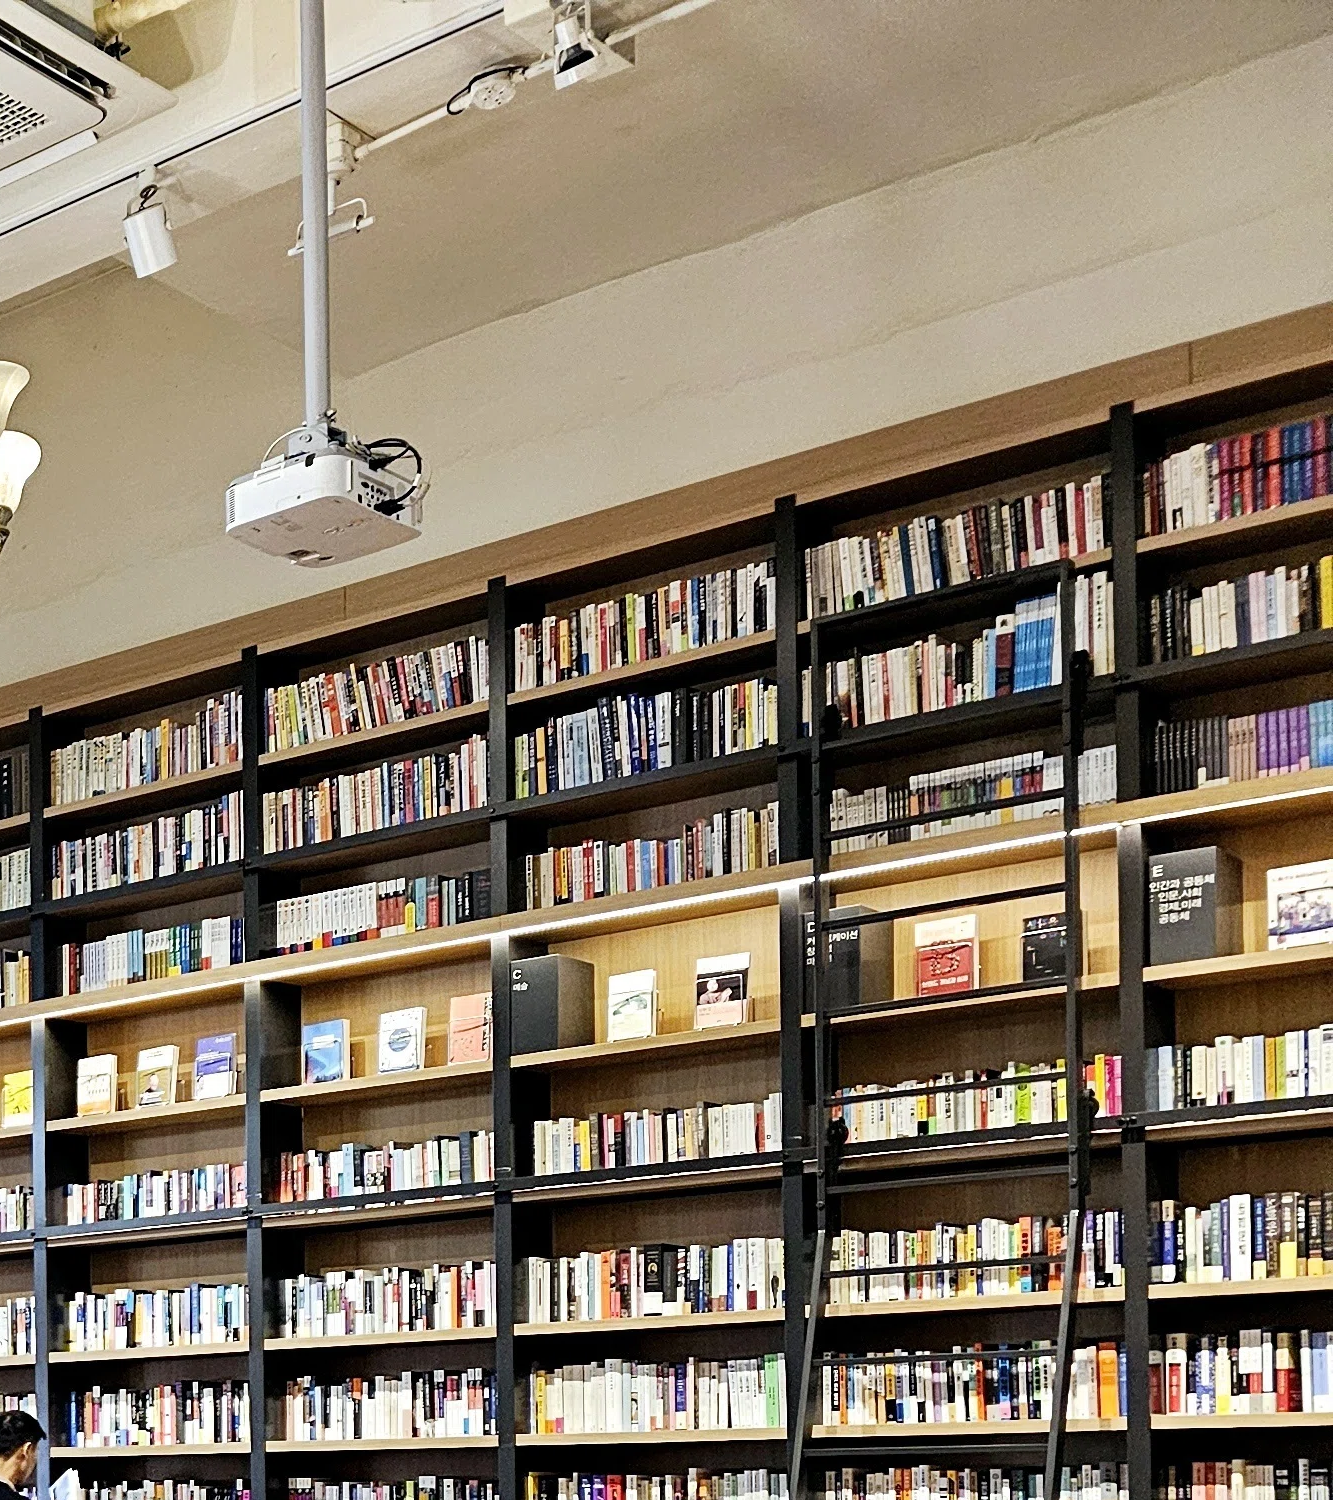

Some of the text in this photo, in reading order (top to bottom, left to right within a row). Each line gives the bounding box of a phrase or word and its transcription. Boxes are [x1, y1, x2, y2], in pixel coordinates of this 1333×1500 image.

[1152, 865, 1163, 877] E
[1150, 875, 1215, 892] 인간과 공동체
[1159, 912, 1190, 924] 공동체
[513, 970, 521, 979] C
